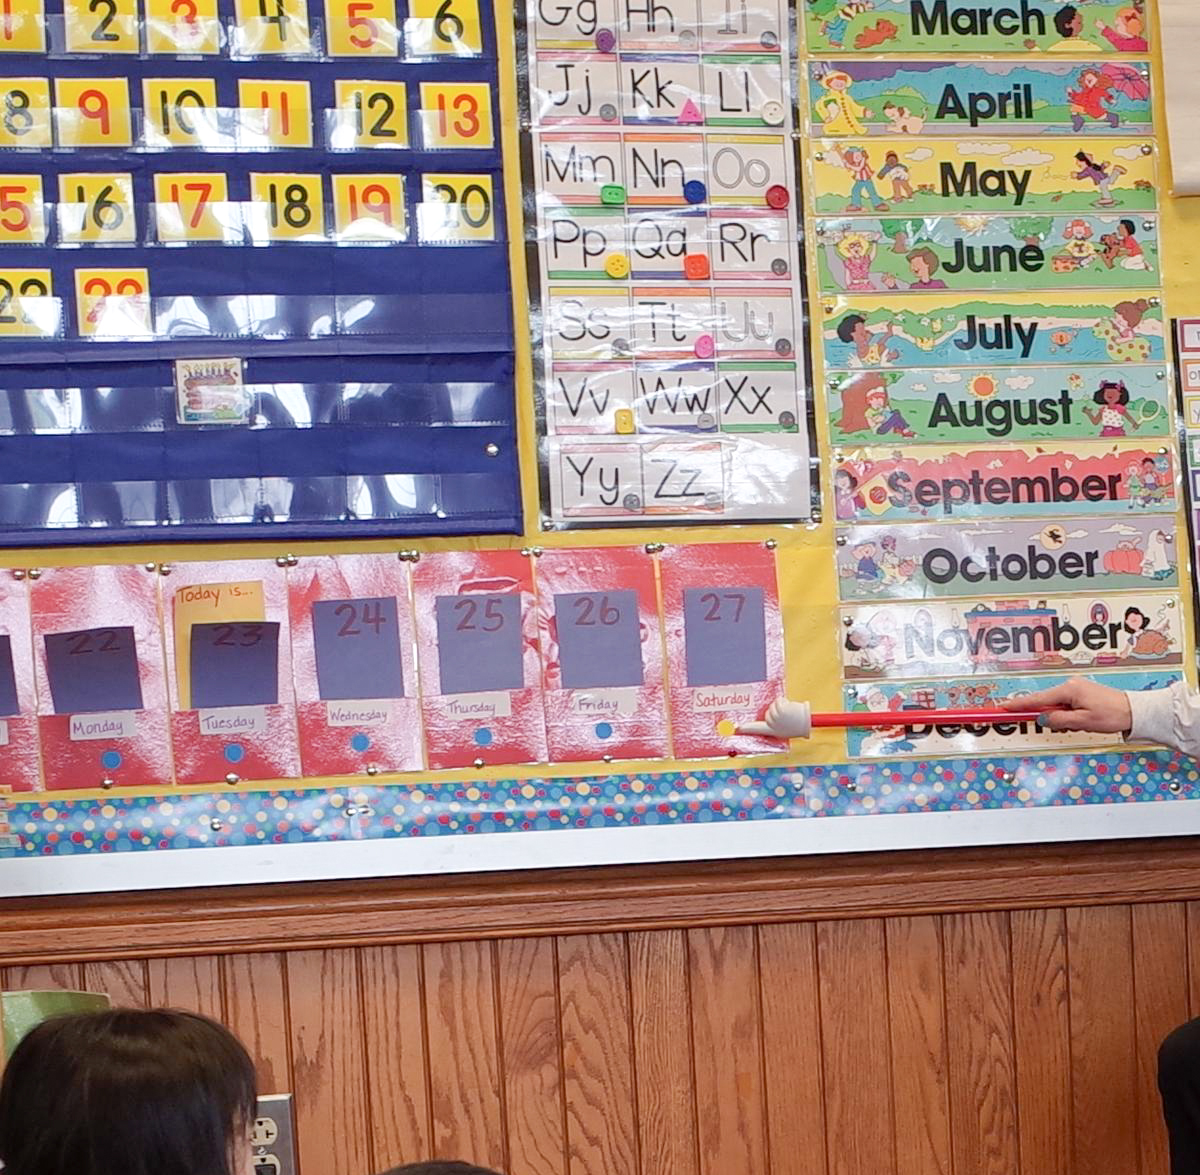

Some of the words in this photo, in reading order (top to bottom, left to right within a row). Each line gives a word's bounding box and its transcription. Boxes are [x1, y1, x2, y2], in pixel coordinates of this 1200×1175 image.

[89, 0, 121, 42] 2
[170, 0, 198, 38] 3
[259, 0, 288, 41] 4
[347, 2, 380, 48] 5
[434, 0, 464, 43] 6
[539, 0, 598, 35] Gg
[627, 0, 675, 33] Hh
[910, 0, 1047, 36] March
[548, 65, 591, 116] Jj
[630, 67, 676, 109] Kk
[718, 71, 751, 113] Ll
[935, 83, 1034, 127] April
[2, 89, 32, 136] 8
[78, 89, 111, 136] 9
[160, 90, 208, 136] 10
[260, 90, 290, 137] 11
[354, 92, 397, 137] 12
[437, 93, 481, 138] 13
[544, 144, 616, 183] Mm
[632, 147, 686, 189] Nn
[712, 147, 771, 189] Oo
[939, 161, 1032, 206] May
[0, 184, 32, 232] 5
[76, 184, 125, 232] 16
[171, 183, 213, 229] 17
[269, 183, 313, 229] 18
[349, 184, 392, 226] 19
[434, 183, 492, 229] 20
[552, 219, 608, 268] Pp
[718, 222, 773, 263] Rr
[941, 237, 1046, 274] June
[558, 299, 611, 342] Ss
[637, 300, 687, 343] Tt
[720, 301, 775, 343] Uu
[953, 313, 1040, 359] July
[558, 376, 611, 418] Vv
[639, 376, 712, 416] Ww
[723, 375, 774, 416] Xx
[927, 389, 1074, 437] August
[566, 455, 620, 507] Yy
[650, 458, 706, 499] Zz
[888, 466, 1123, 514] September
[921, 544, 1100, 584] October
[175, 586, 221, 608] Today
[453, 598, 505, 632] 25
[574, 596, 621, 626] 26
[700, 593, 747, 623] 27
[211, 623, 265, 648] 23
[333, 602, 387, 637] 24
[903, 615, 1124, 660] November
[69, 629, 122, 655] 22
[329, 706, 389, 724] Wednesday
[446, 701, 497, 718] Thursday
[577, 697, 620, 713] Friday
[696, 692, 752, 709] Saturday
[72, 719, 124, 738] Monday
[202, 714, 256, 732] Tuesday
